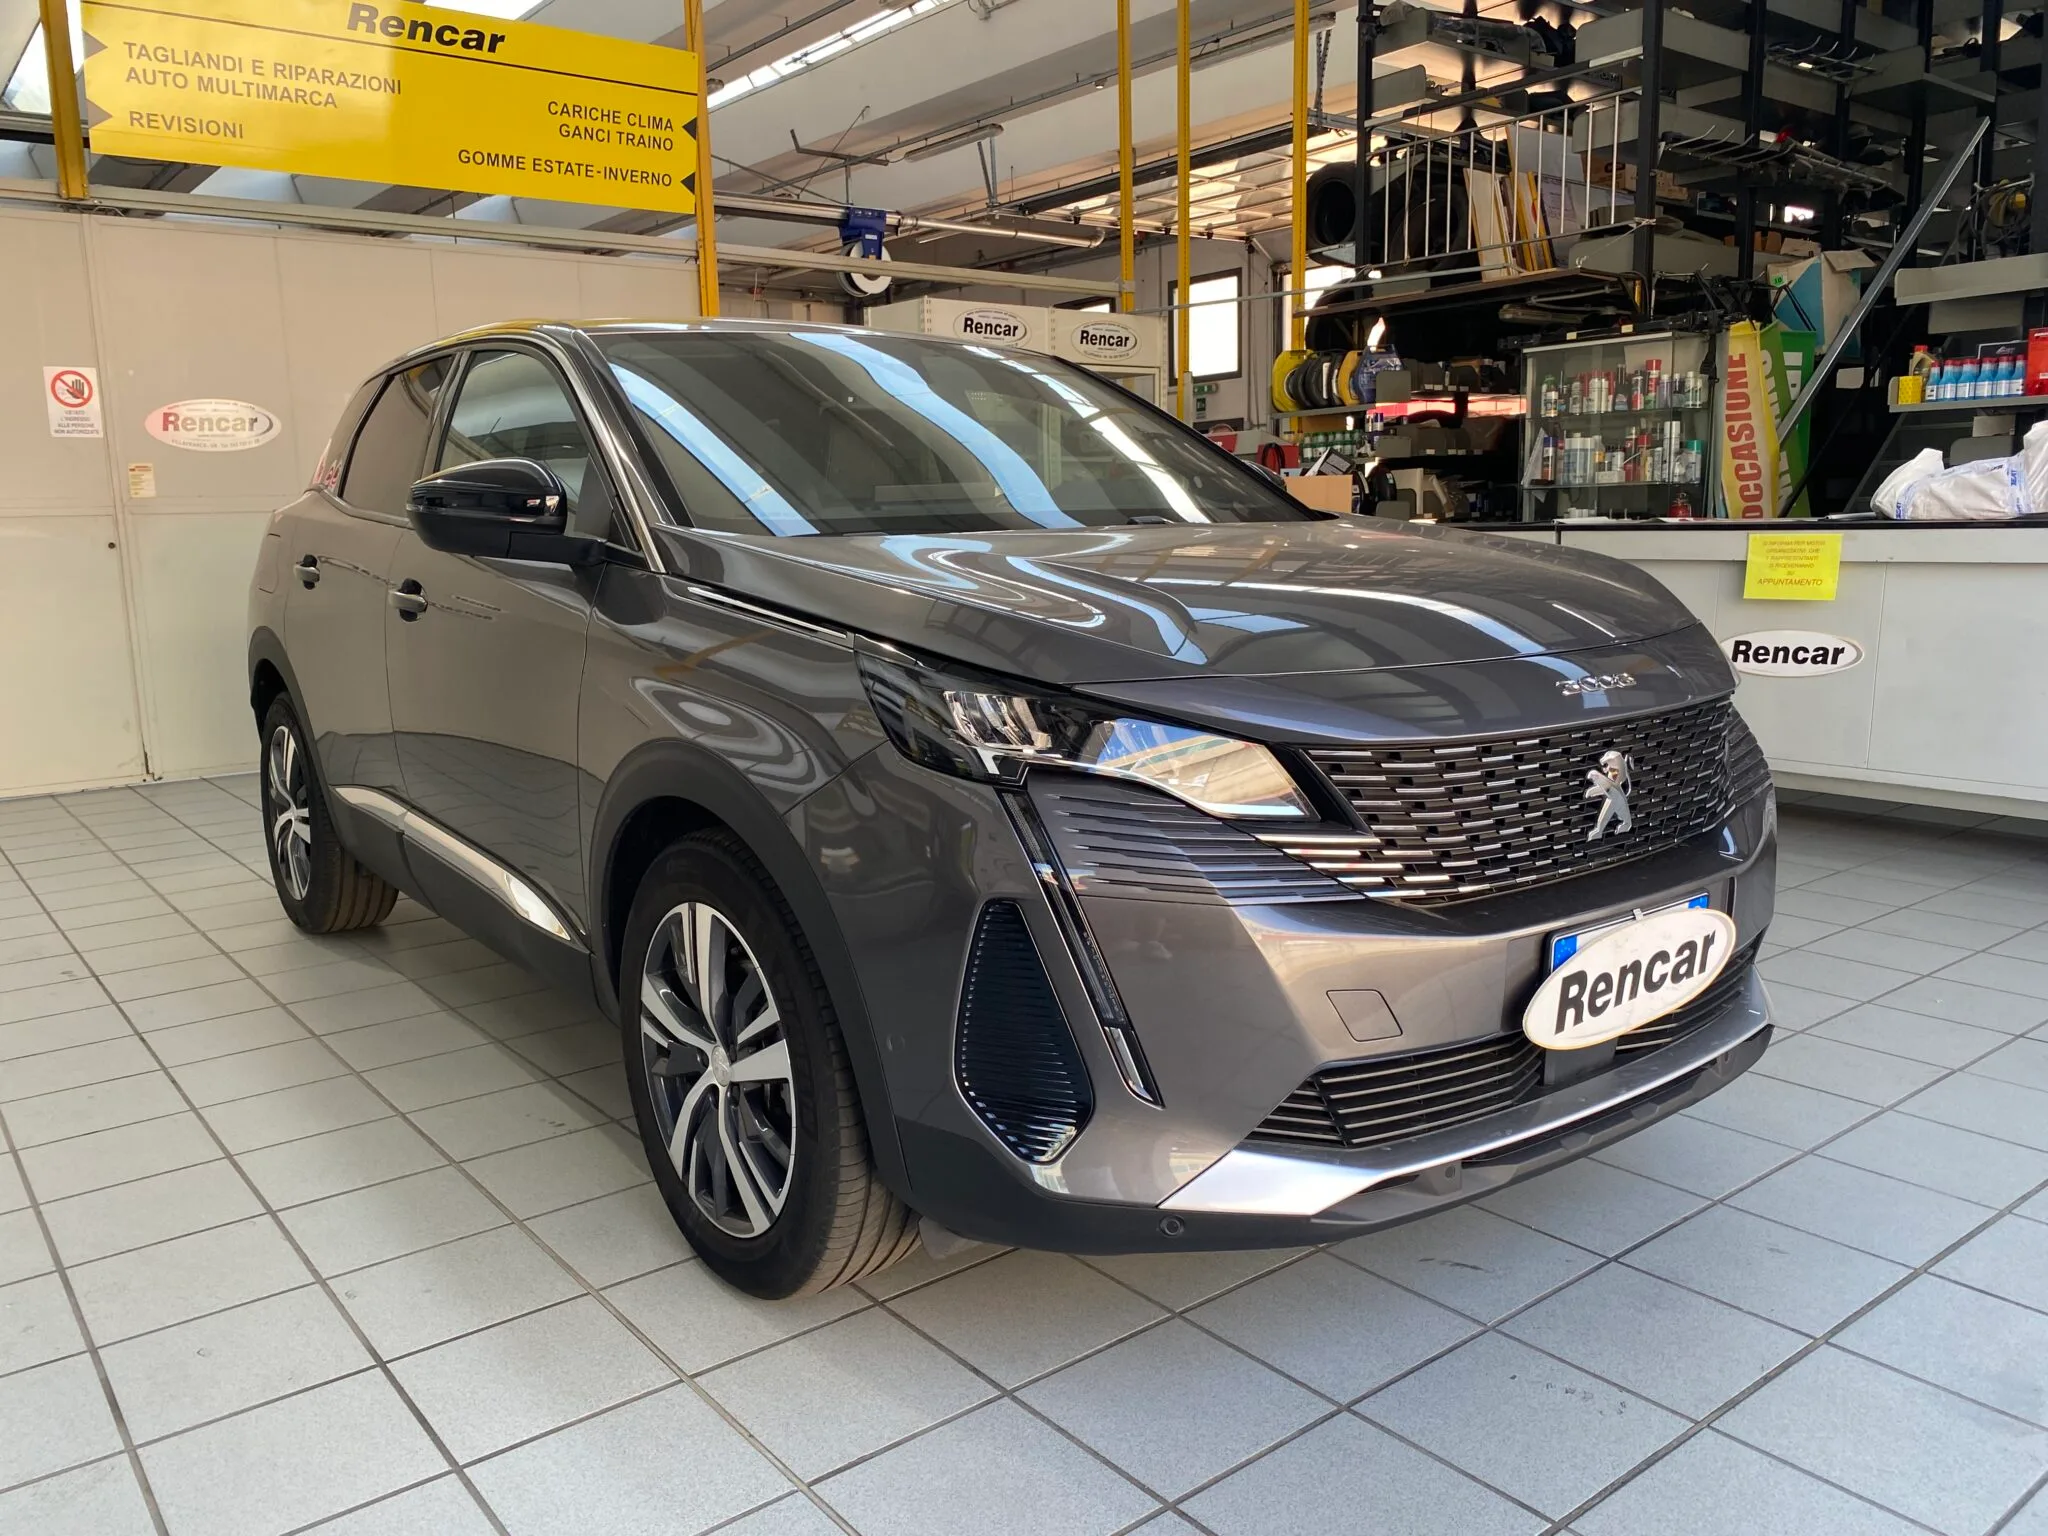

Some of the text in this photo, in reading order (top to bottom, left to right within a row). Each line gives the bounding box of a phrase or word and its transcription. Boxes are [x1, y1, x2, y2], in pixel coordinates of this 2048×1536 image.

[347, 3, 505, 53] Rencar
[123, 41, 402, 95] TAGLIANDI E RIPARAZIONI
[125, 67, 337, 108] AUTO MULTIMARCA
[129, 111, 243, 139] REVISIONI
[548, 101, 674, 132] CARICHE CLIMA
[559, 123, 674, 151] GANCI TRAINO
[458, 150, 672, 187] GOMME ESTATE-INVERNO
[963, 317, 1019, 337] Rencar
[1079, 330, 1130, 348] Rencar
[162, 412, 258, 432] Rencar
[1757, 578, 1823, 587] APPUNTAMENTO
[1731, 640, 1845, 666] Rencar
[1554, 930, 1717, 1036] Rencar
